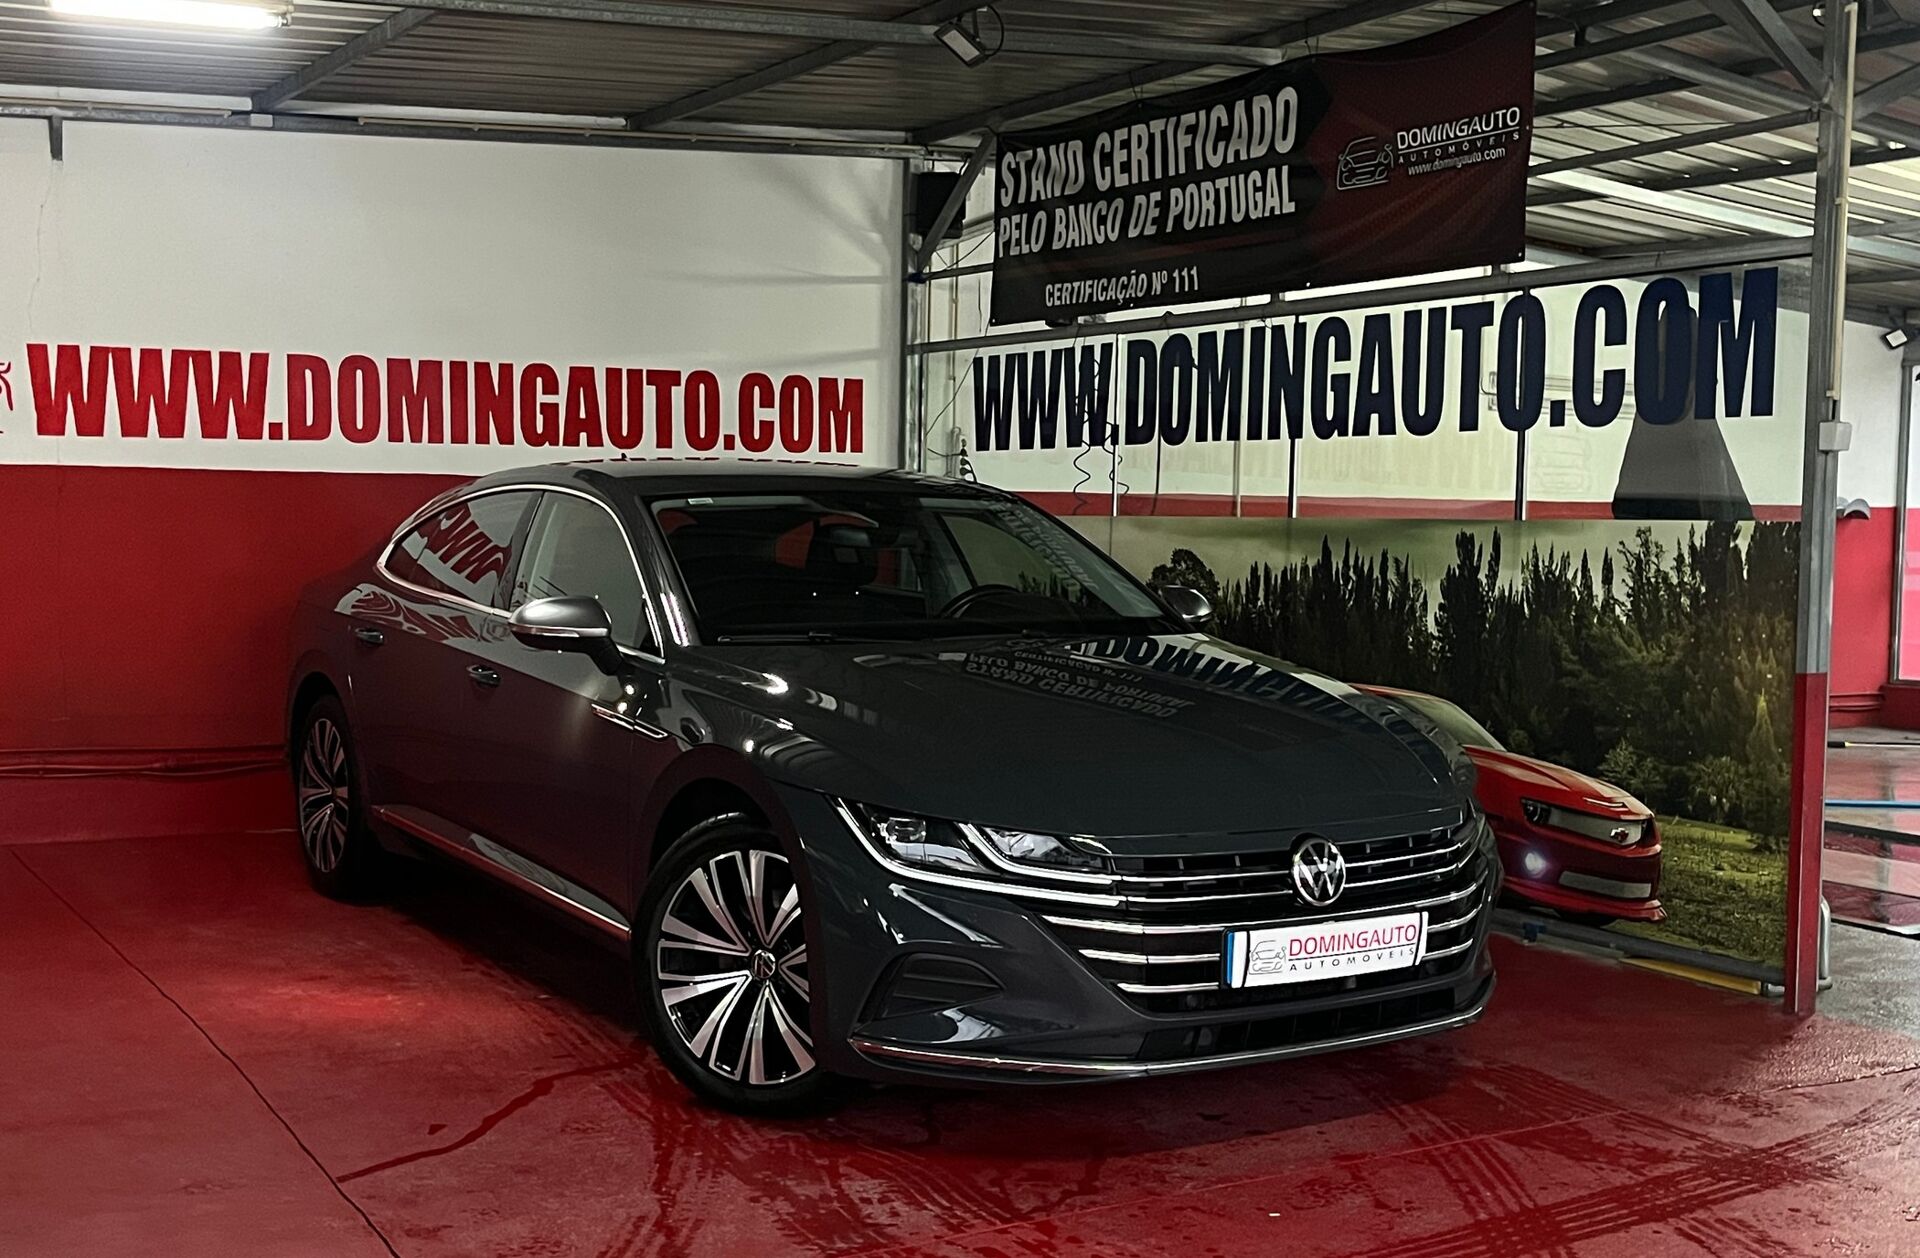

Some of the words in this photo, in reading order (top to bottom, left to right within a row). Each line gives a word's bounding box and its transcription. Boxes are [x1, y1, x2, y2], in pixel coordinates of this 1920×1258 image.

[1000, 139, 1084, 207] STAND
[1093, 86, 1298, 192] CERTIFICADO
[1397, 106, 1520, 150] DOMINGAUTO
[1407, 146, 1506, 176] www.domingauto.com
[998, 210, 1047, 258] PELO
[1052, 197, 1124, 250] BANCO
[1127, 190, 1162, 238] DE
[1166, 164, 1296, 233] PORTUGAL
[1045, 269, 1148, 306] CERTIFICAÇÃO
[1173, 265, 1199, 293] 111
[973, 267, 1779, 452] WWW.DOMINGAUTO.COM
[26, 343, 865, 453] WWW.DOMINGAUTO.COM
[1289, 923, 1418, 957] DOMINGAUTO
